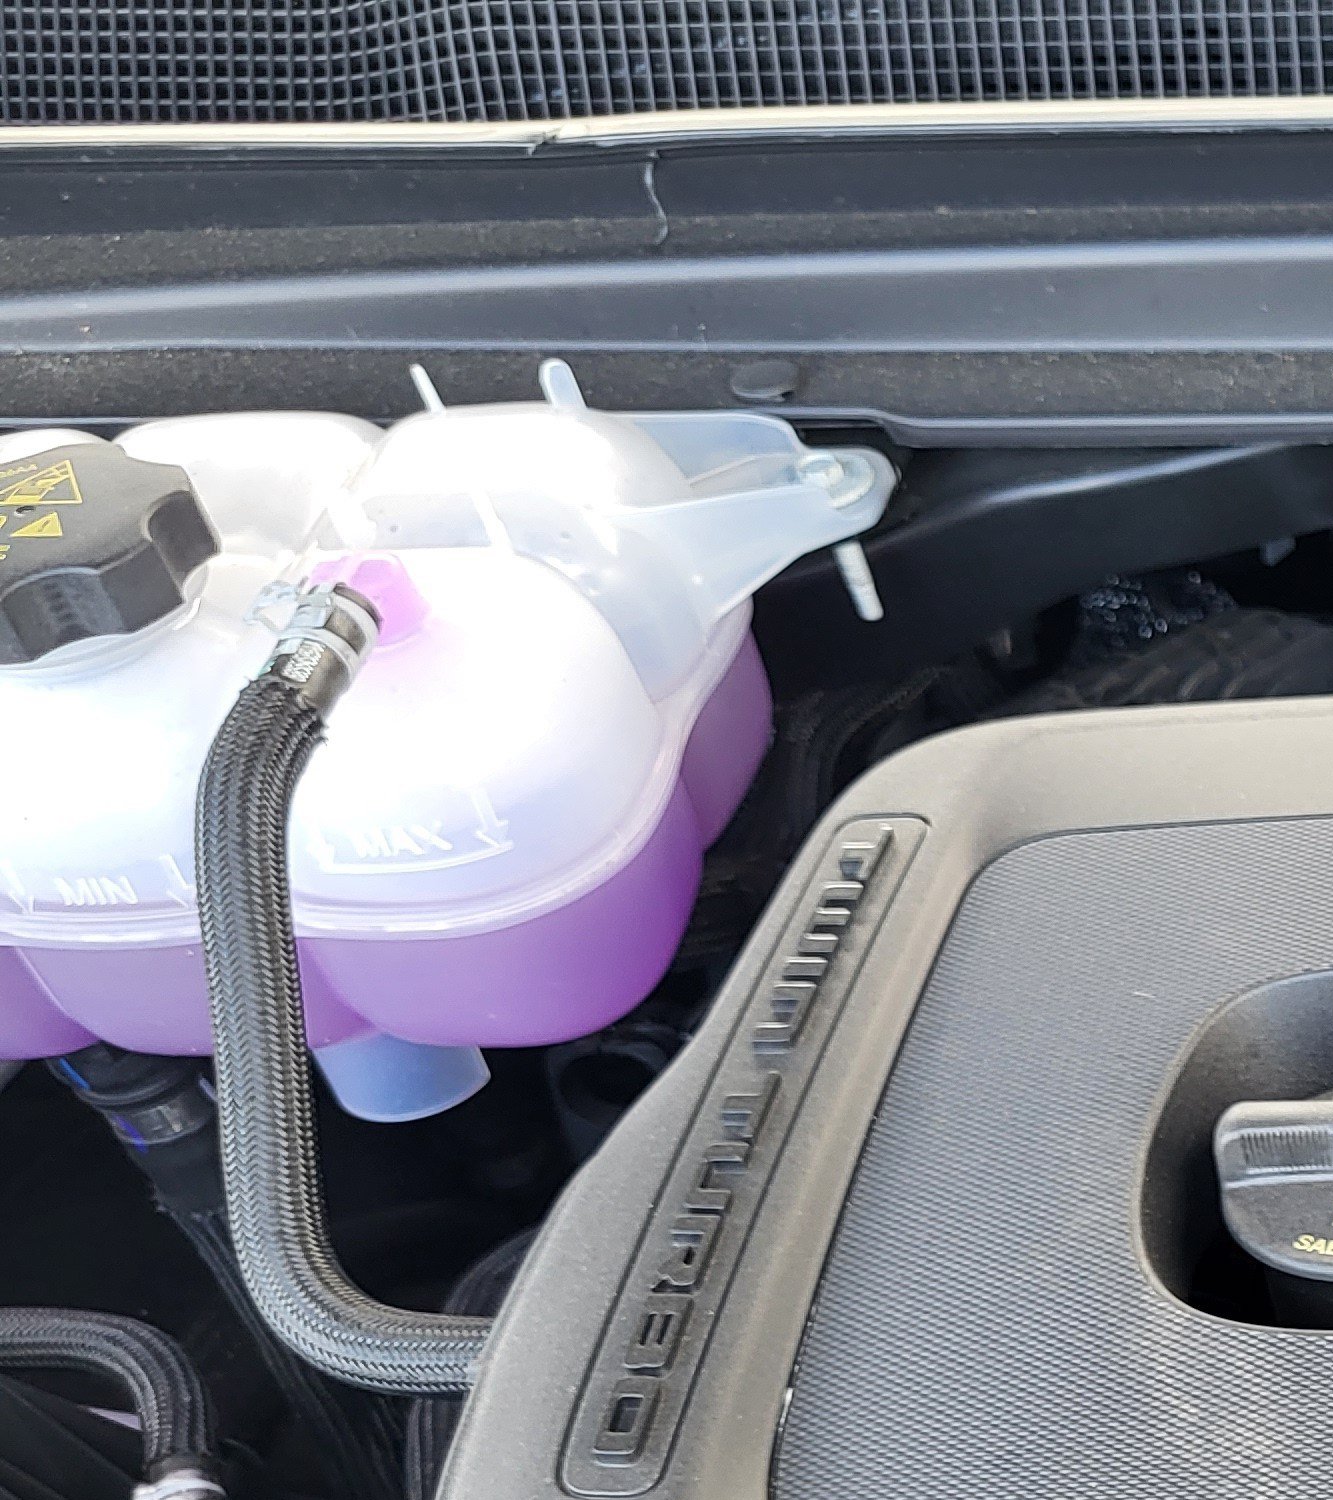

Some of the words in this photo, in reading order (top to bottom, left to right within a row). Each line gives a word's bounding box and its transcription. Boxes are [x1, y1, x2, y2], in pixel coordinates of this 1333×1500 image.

[351, 820, 454, 860] MAX
[53, 875, 139, 907] MIN
[593, 1071, 782, 1468] TURBO
